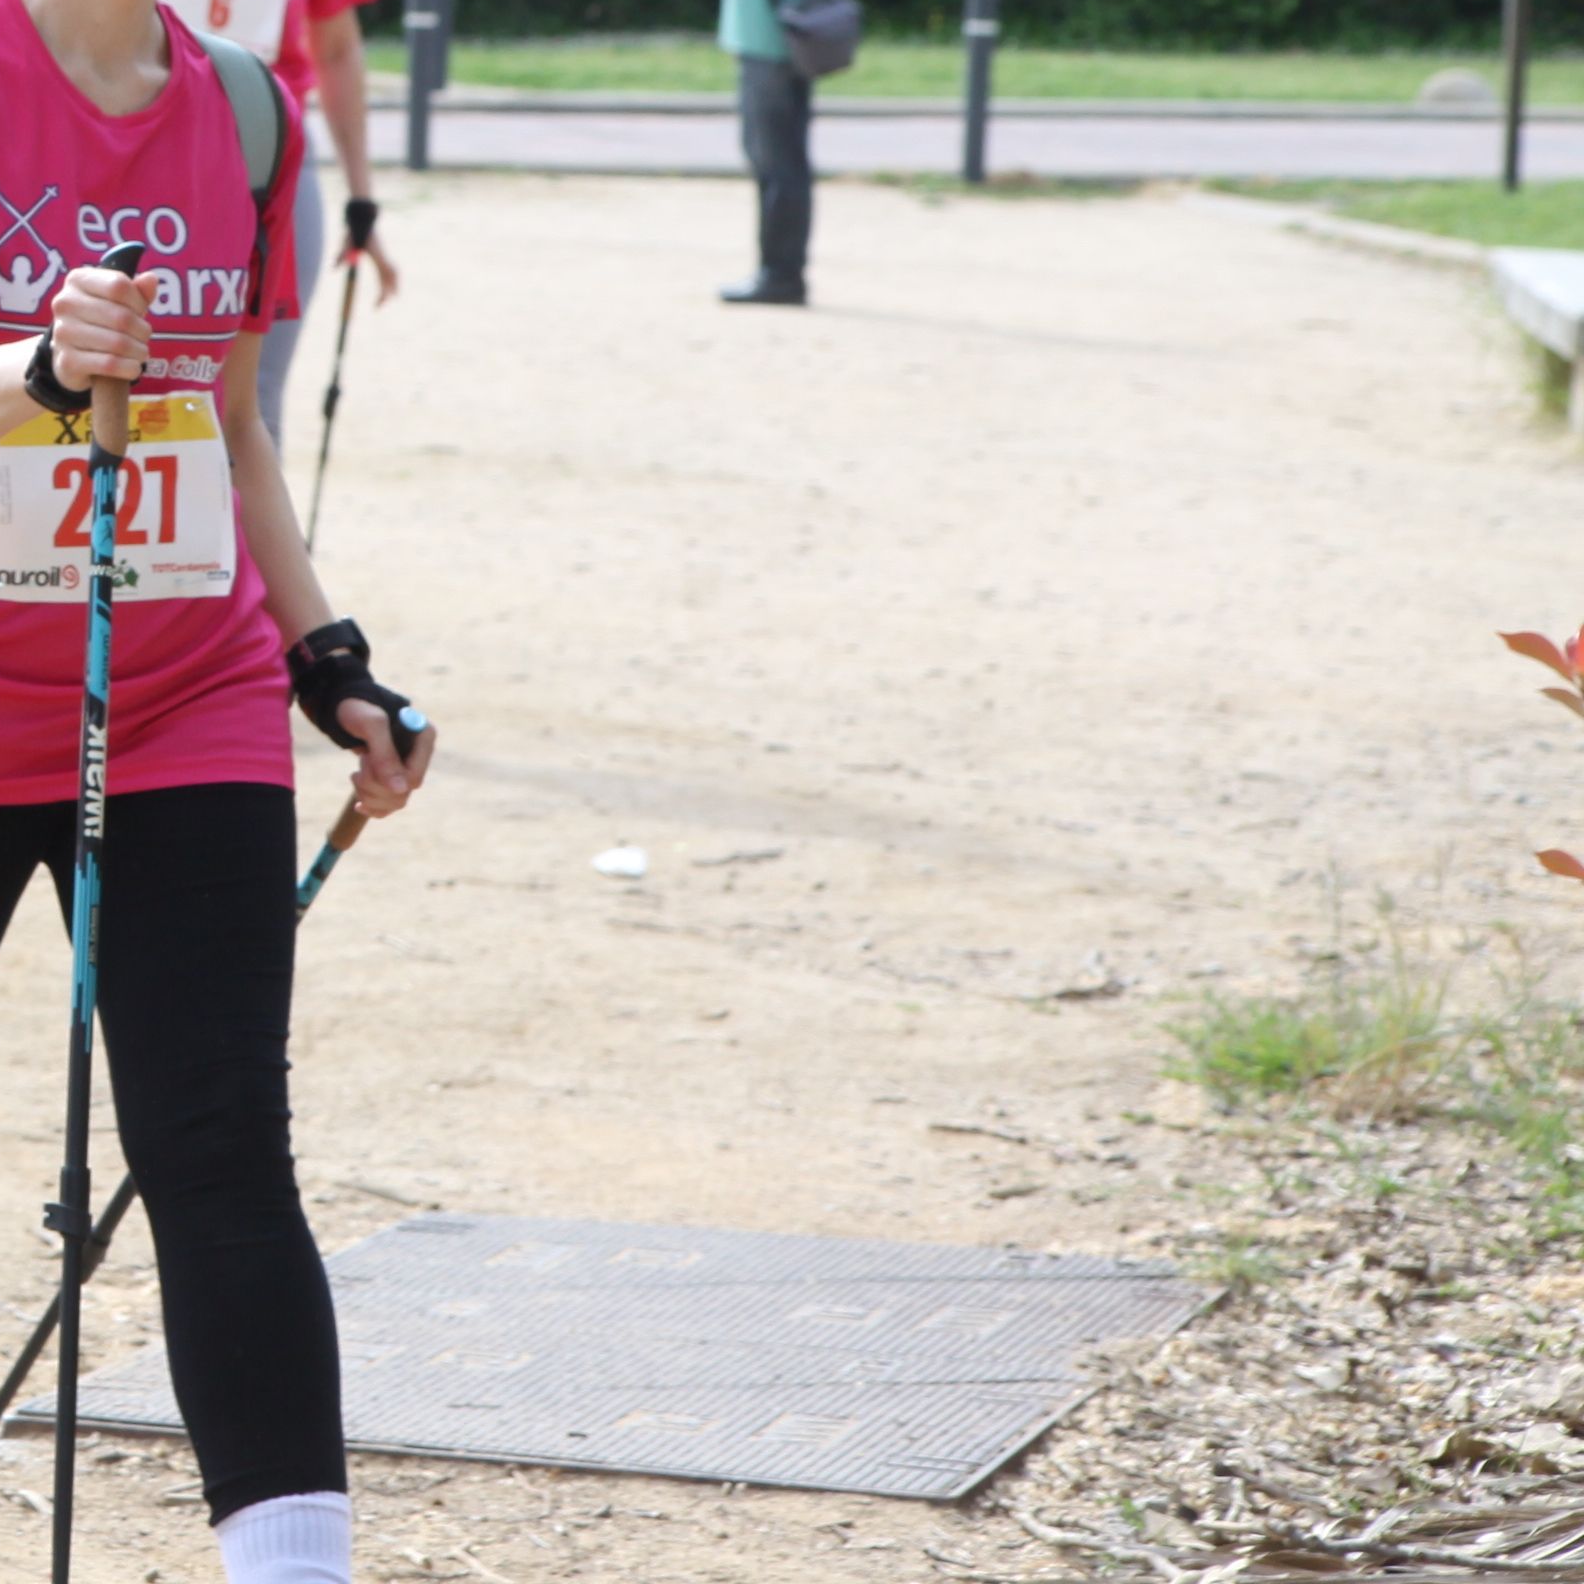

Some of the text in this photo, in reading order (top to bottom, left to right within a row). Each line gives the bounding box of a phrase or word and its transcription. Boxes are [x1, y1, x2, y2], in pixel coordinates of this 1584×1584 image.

[77, 204, 188, 255] eco
[170, 354, 220, 384] Colls
[53, 454, 178, 548] 227
